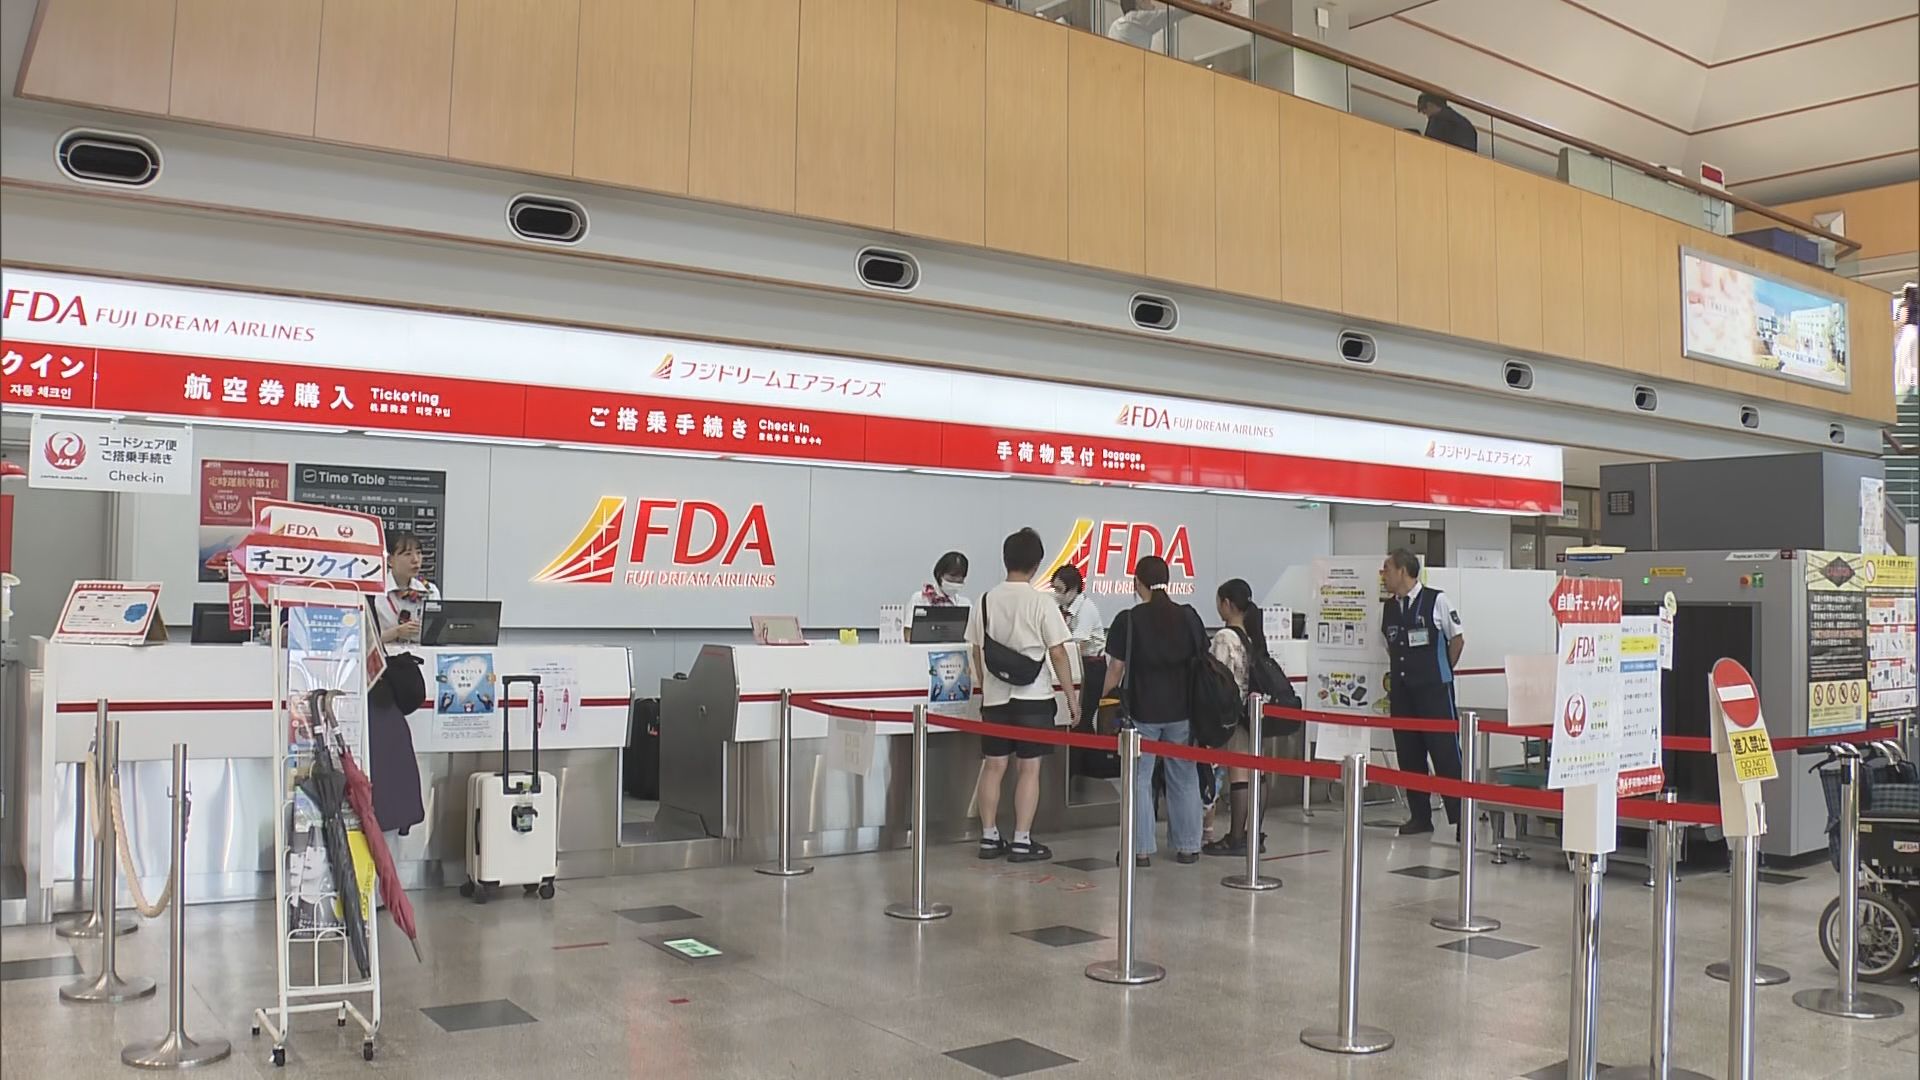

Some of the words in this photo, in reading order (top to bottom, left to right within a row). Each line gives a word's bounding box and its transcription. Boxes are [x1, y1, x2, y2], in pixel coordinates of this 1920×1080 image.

[2, 289, 88, 326] FDA
[95, 307, 137, 328] FUJI
[145, 312, 220, 333] DREAM
[224, 320, 316, 342] AIRLINES
[2, 350, 85, 379] クイン
[680, 361, 886, 398] フジドリームエアラインズ
[184, 372, 355, 410] 航空券購入
[370, 387, 439, 407] Ticketing
[589, 406, 748, 440] ご搭乗手続き
[758, 419, 796, 433] Check
[1130, 405, 1170, 430] FDA
[1173, 416, 1193, 431] FUJI
[1195, 419, 1230, 433] DREAM
[1232, 424, 1275, 438] AIRLINES
[98, 435, 177, 452] コードシェア便
[54, 458, 78, 467] JAL
[101, 449, 173, 465] ご搭乗手続き
[996, 440, 1095, 467] 手荷物受付
[1102, 448, 1141, 462] Baggage
[1439, 445, 1532, 466] フジドリームエアラインズ
[108, 469, 164, 484] Check-in
[318, 471, 349, 484] Time
[351, 473, 385, 486] Table
[364, 505, 396, 516] 10:00
[286, 523, 319, 537] FDA
[627, 498, 776, 567] FDA
[1095, 521, 1195, 578] FDA
[624, 570, 655, 588] FUJI
[657, 570, 711, 587] DREAM
[711, 572, 776, 588] AIRLINES
[1093, 580, 1113, 595] FUJI
[1557, 593, 1620, 612] 自動チェックイン
[1576, 636, 1595, 657] FDA
[1733, 734, 1768, 755] 進入禁止
[1740, 760, 1752, 769] DO
[1752, 757, 1767, 767] NOT
[1744, 766, 1768, 778] ENTER
